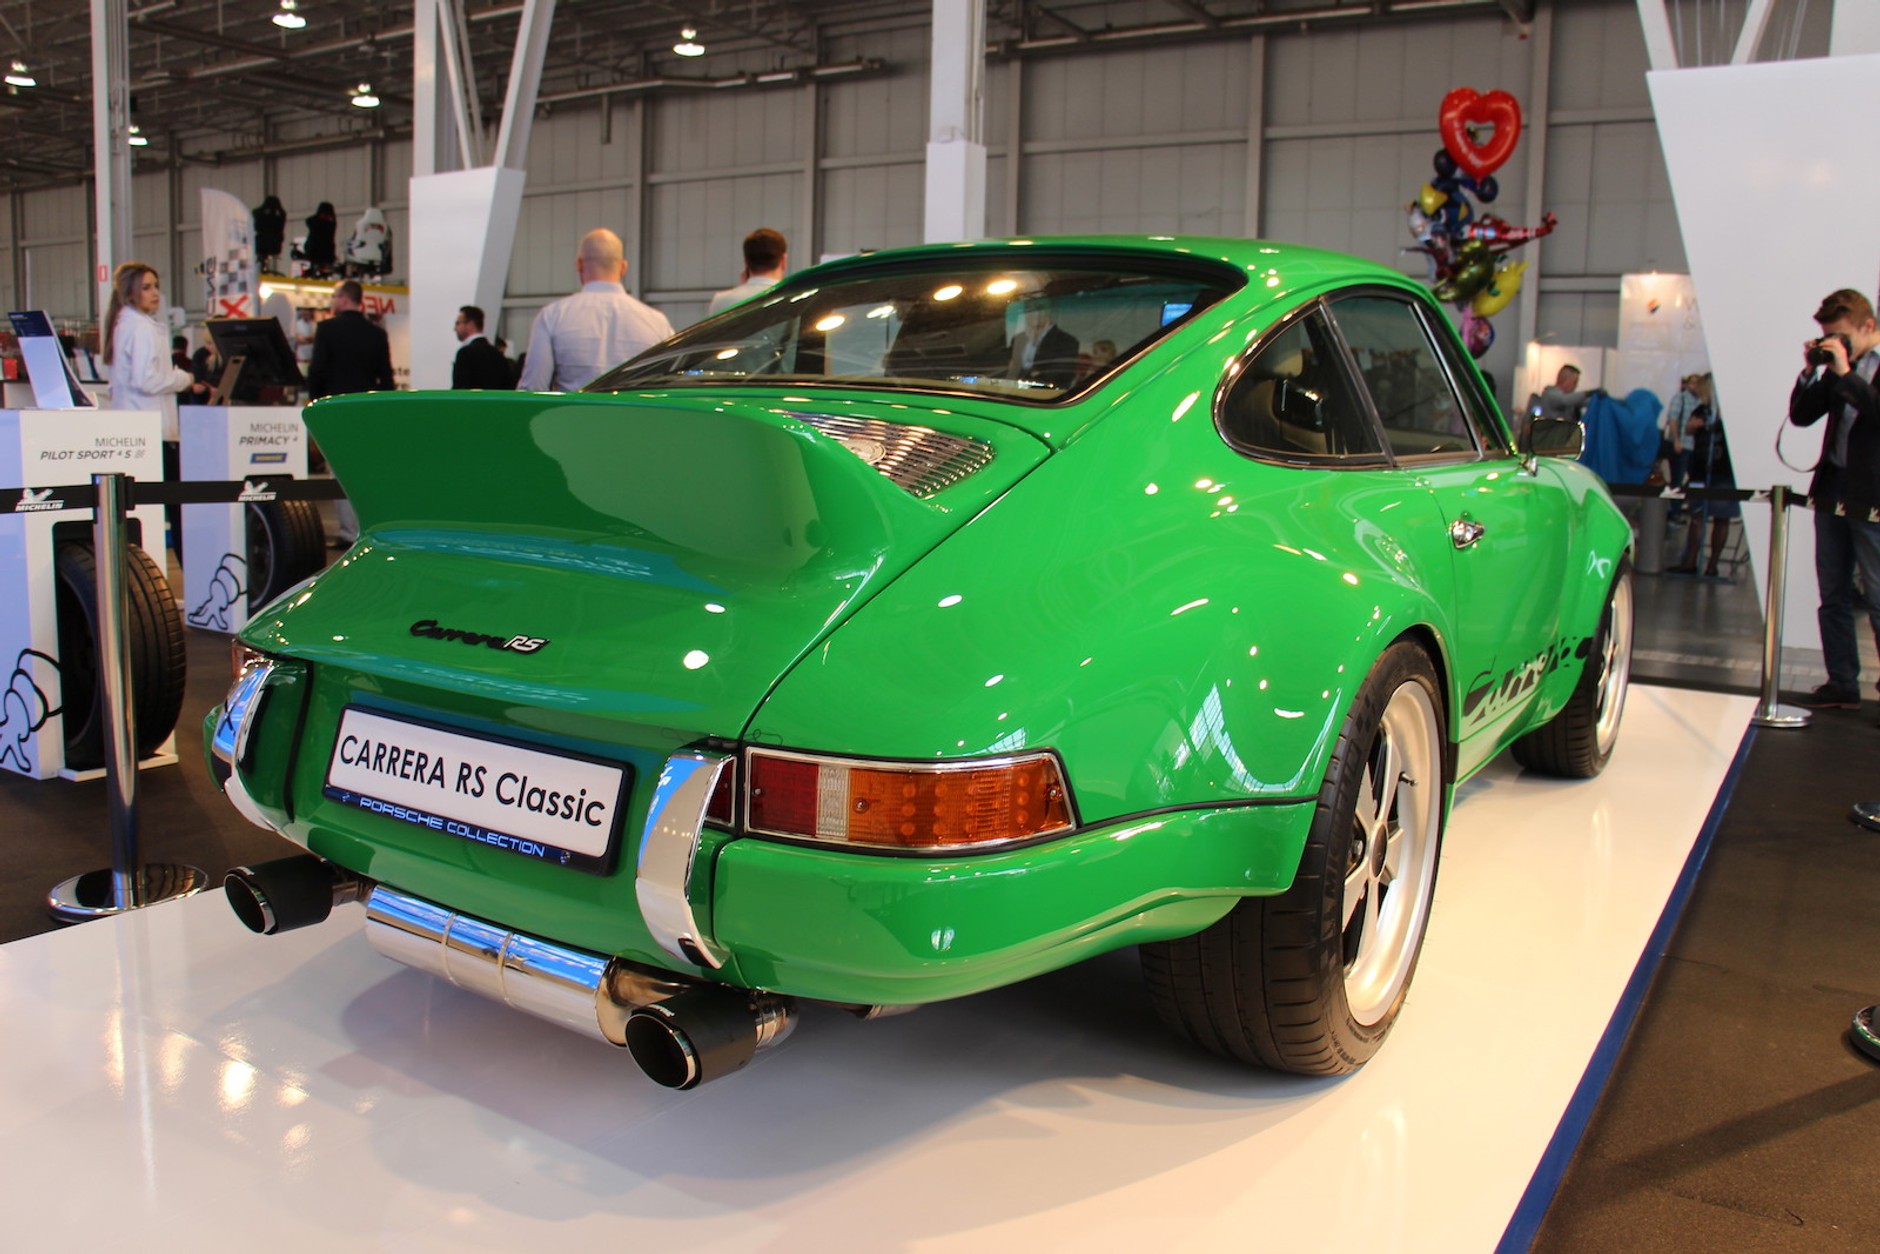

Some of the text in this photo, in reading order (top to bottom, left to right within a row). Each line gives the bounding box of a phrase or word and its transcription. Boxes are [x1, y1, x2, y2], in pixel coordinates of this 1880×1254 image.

[249, 422, 299, 433] MICHELIN
[94, 437, 147, 448] MICHELIN
[238, 436, 290, 446] PRIMACY
[40, 450, 75, 461] PILOT
[76, 449, 115, 460] SPORT
[124, 449, 132, 459] S
[14, 502, 64, 512] MICHELIN
[409, 619, 550, 654] Carrera RS
[339, 734, 606, 827] CARRERA RS Classic
[359, 796, 545, 858] PORSCHE COLLECTION
